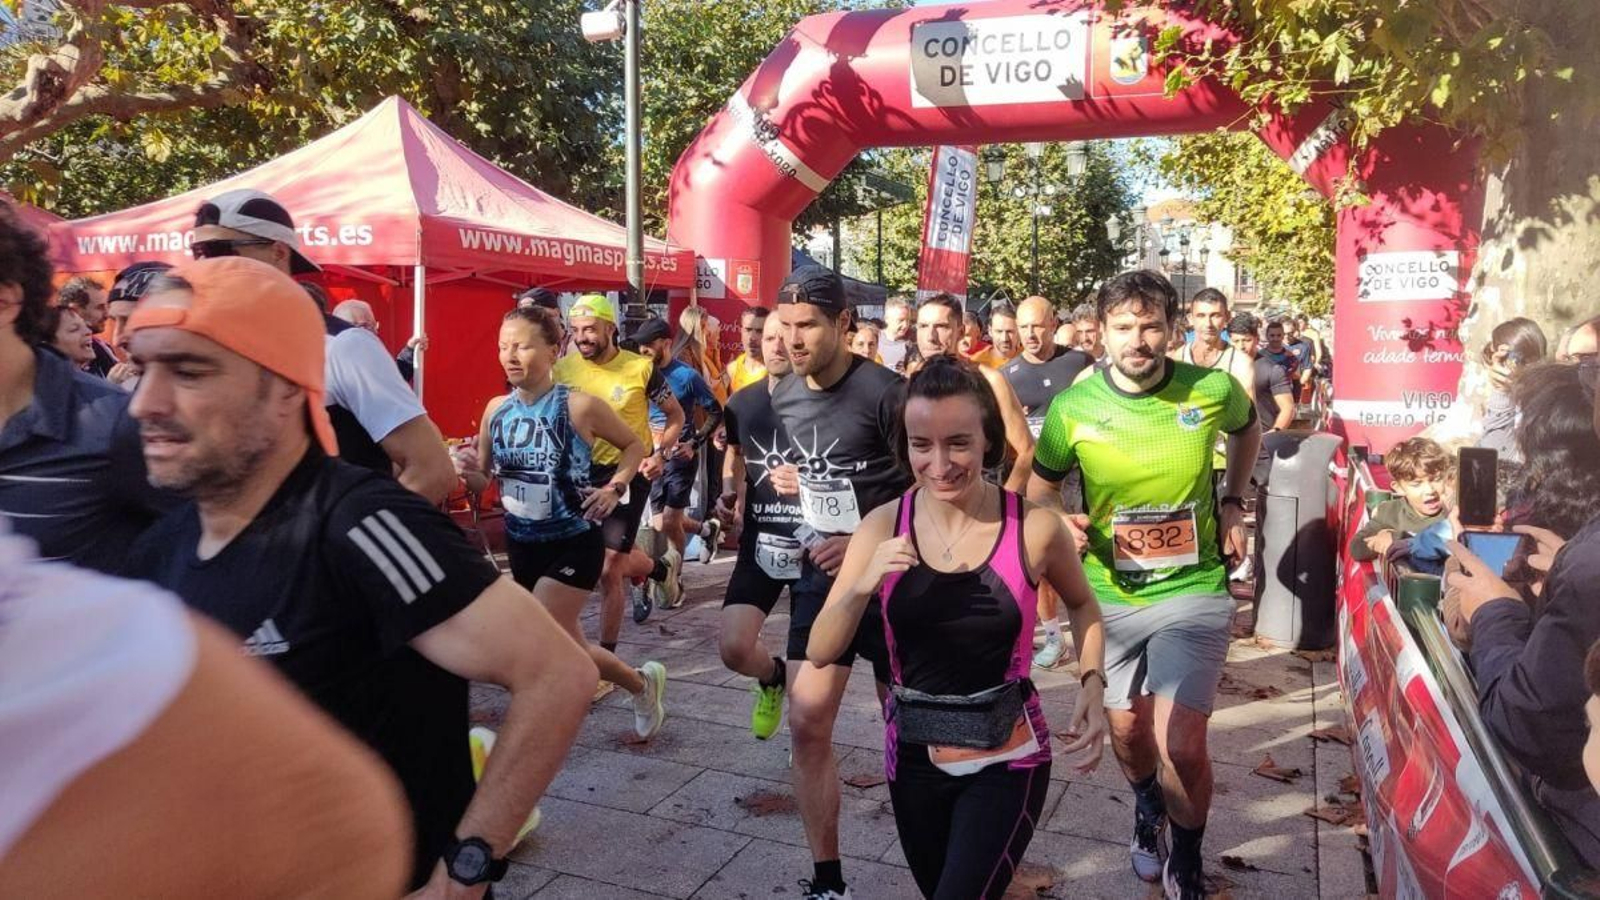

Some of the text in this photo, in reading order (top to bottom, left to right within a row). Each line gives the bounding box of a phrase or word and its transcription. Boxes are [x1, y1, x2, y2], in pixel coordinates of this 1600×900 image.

[923, 29, 1071, 59] CONCELLO
[940, 59, 1052, 87] DE VIGO
[937, 155, 959, 242] CONCELLO
[951, 169, 971, 235] DE VIGO
[1364, 260, 1450, 276] CONCELLO
[1374, 276, 1440, 290] DE VIGO
[1402, 391, 1452, 410] VIGO
[1359, 410, 1415, 427] terreo
[490, 416, 568, 451] ADN
[1127, 525, 1182, 552] 832
